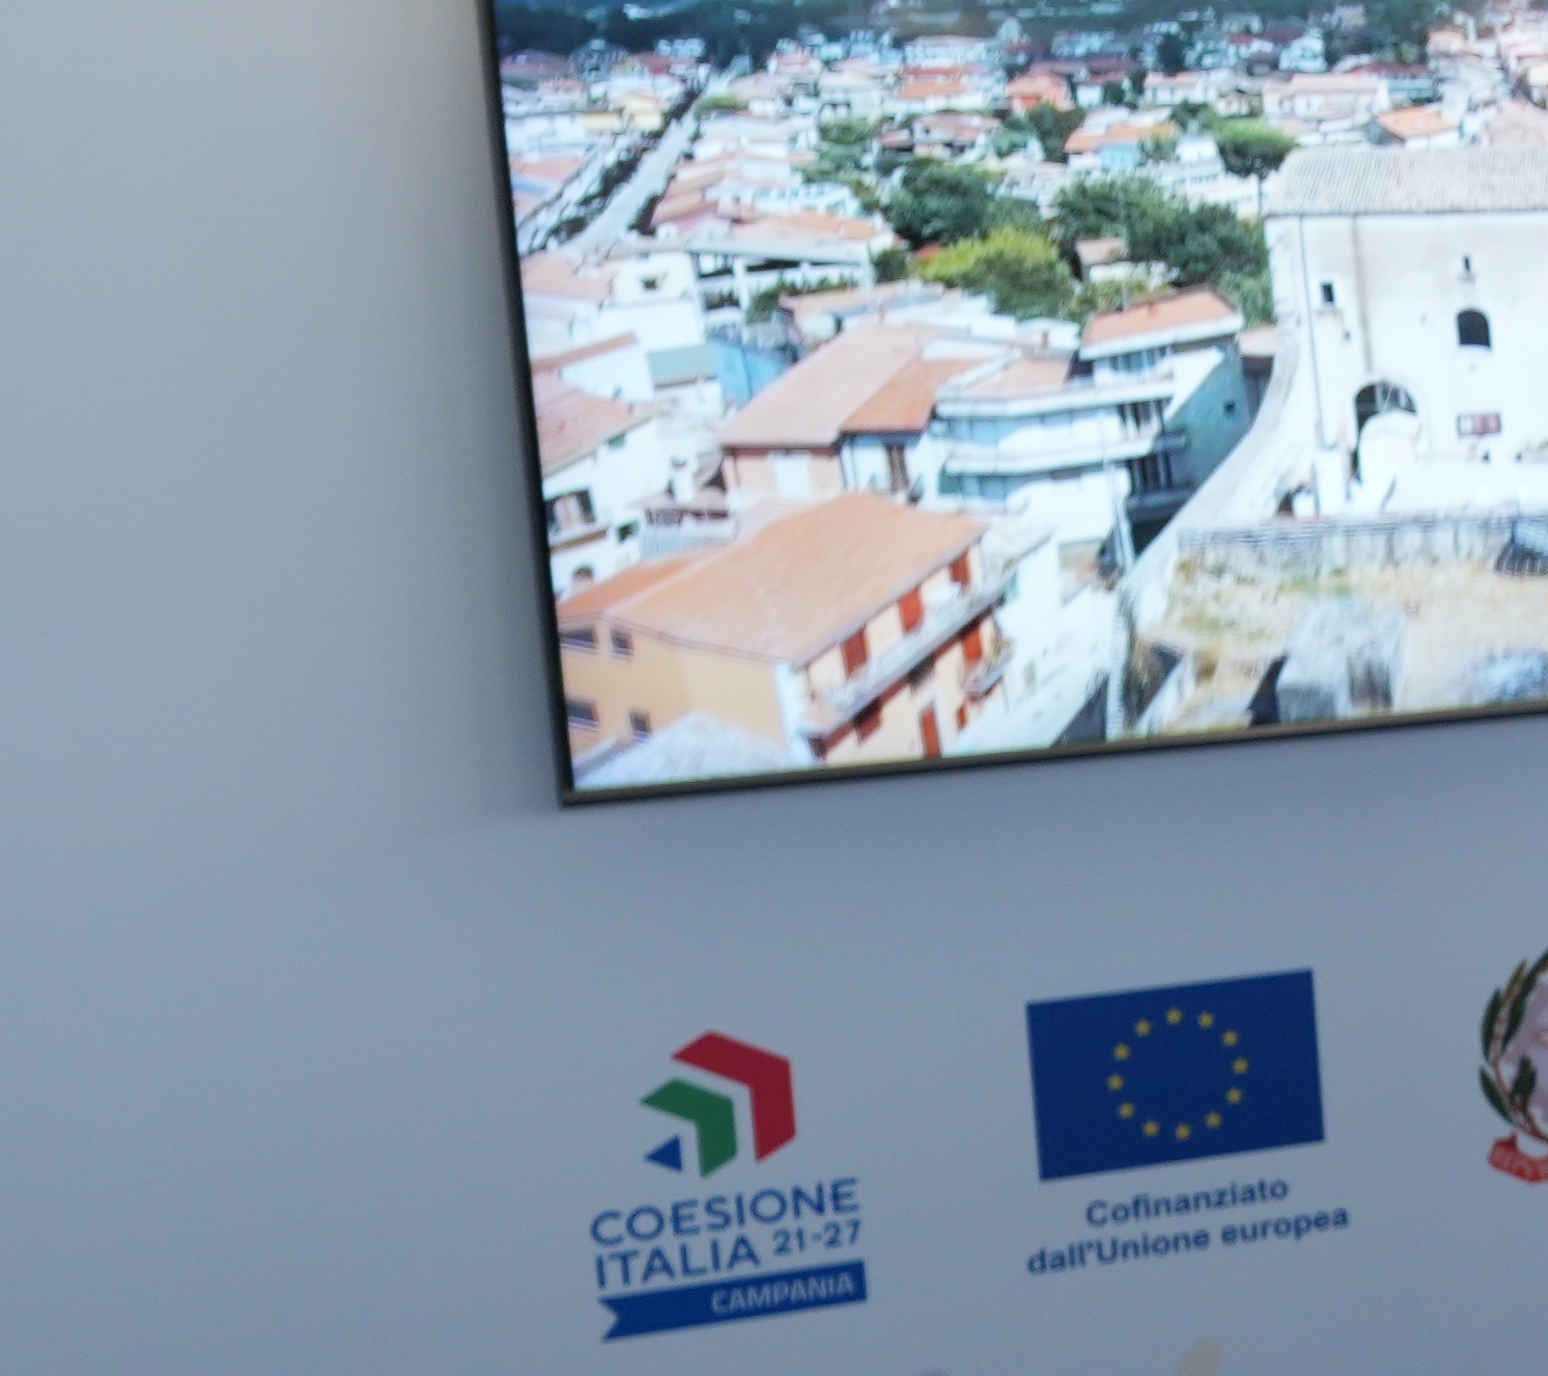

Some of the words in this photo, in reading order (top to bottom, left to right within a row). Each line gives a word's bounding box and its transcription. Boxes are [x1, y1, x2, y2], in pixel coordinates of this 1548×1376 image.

[590, 1176, 860, 1246] COESIONE
[1085, 1179, 1290, 1227] Cofinanziato
[595, 1234, 761, 1289] ITALIA
[772, 1218, 862, 1255] 21-27
[1027, 1228, 1211, 1276] dall'Unione
[1221, 1206, 1349, 1245] europea
[710, 1271, 857, 1315] CAMPANIA
